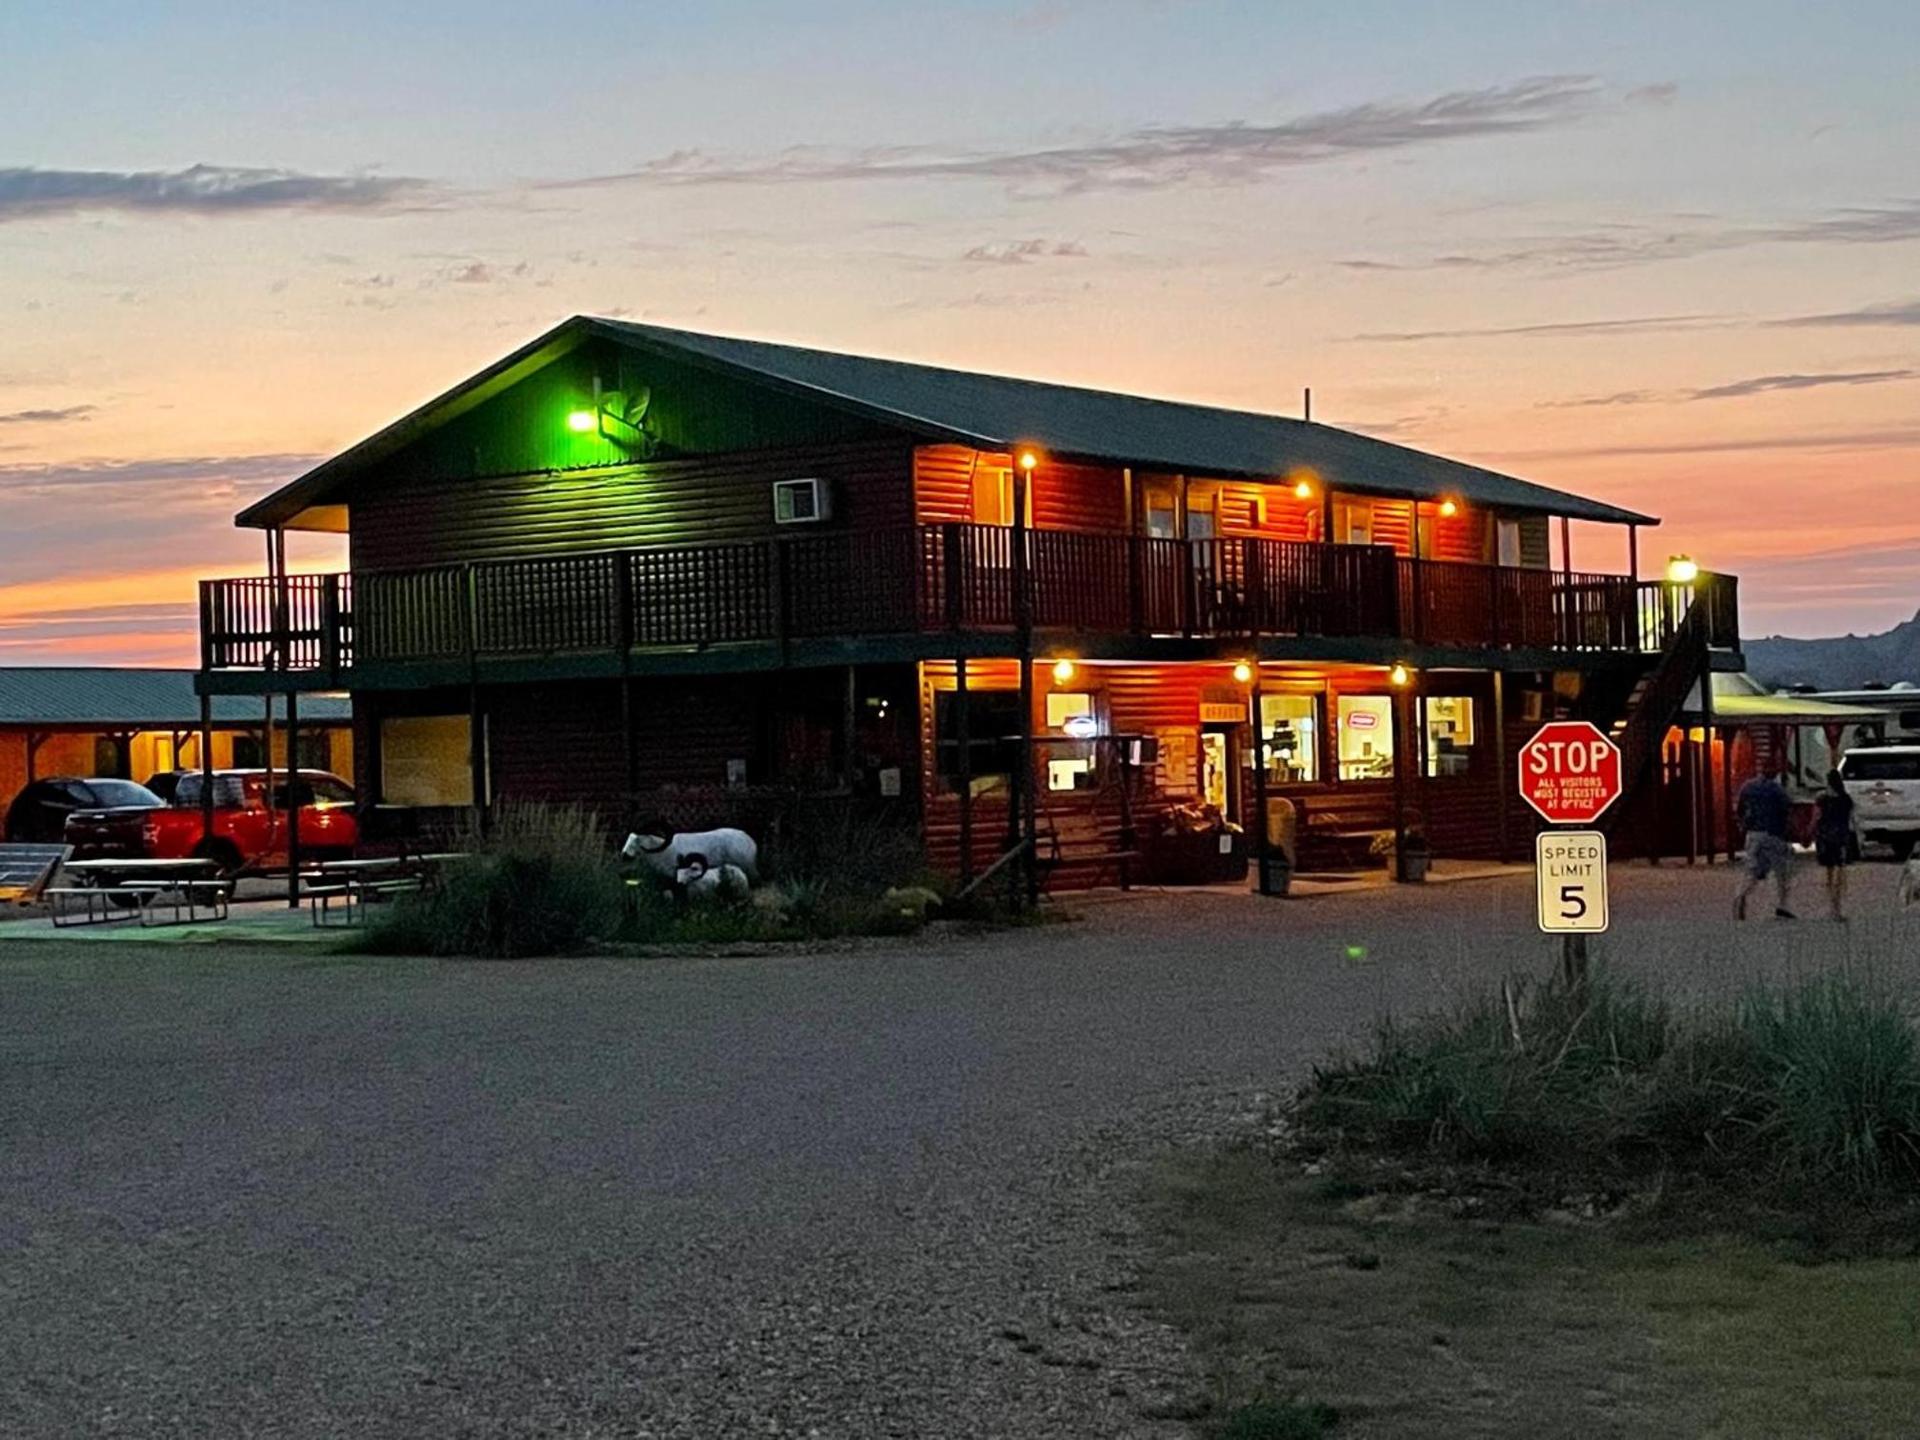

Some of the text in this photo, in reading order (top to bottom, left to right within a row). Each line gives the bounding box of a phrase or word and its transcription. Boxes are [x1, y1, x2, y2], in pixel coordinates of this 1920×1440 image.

[1530, 741, 1609, 774] STOP
[1538, 776, 1602, 787] ALL VISITORS
[1533, 788, 1607, 799] MUST REGISTER
[1547, 799, 1594, 809] AT OFFICE
[1545, 847, 1598, 859] SPEED
[1551, 864, 1592, 876] LIMIT
[1561, 886, 1586, 919] 5
